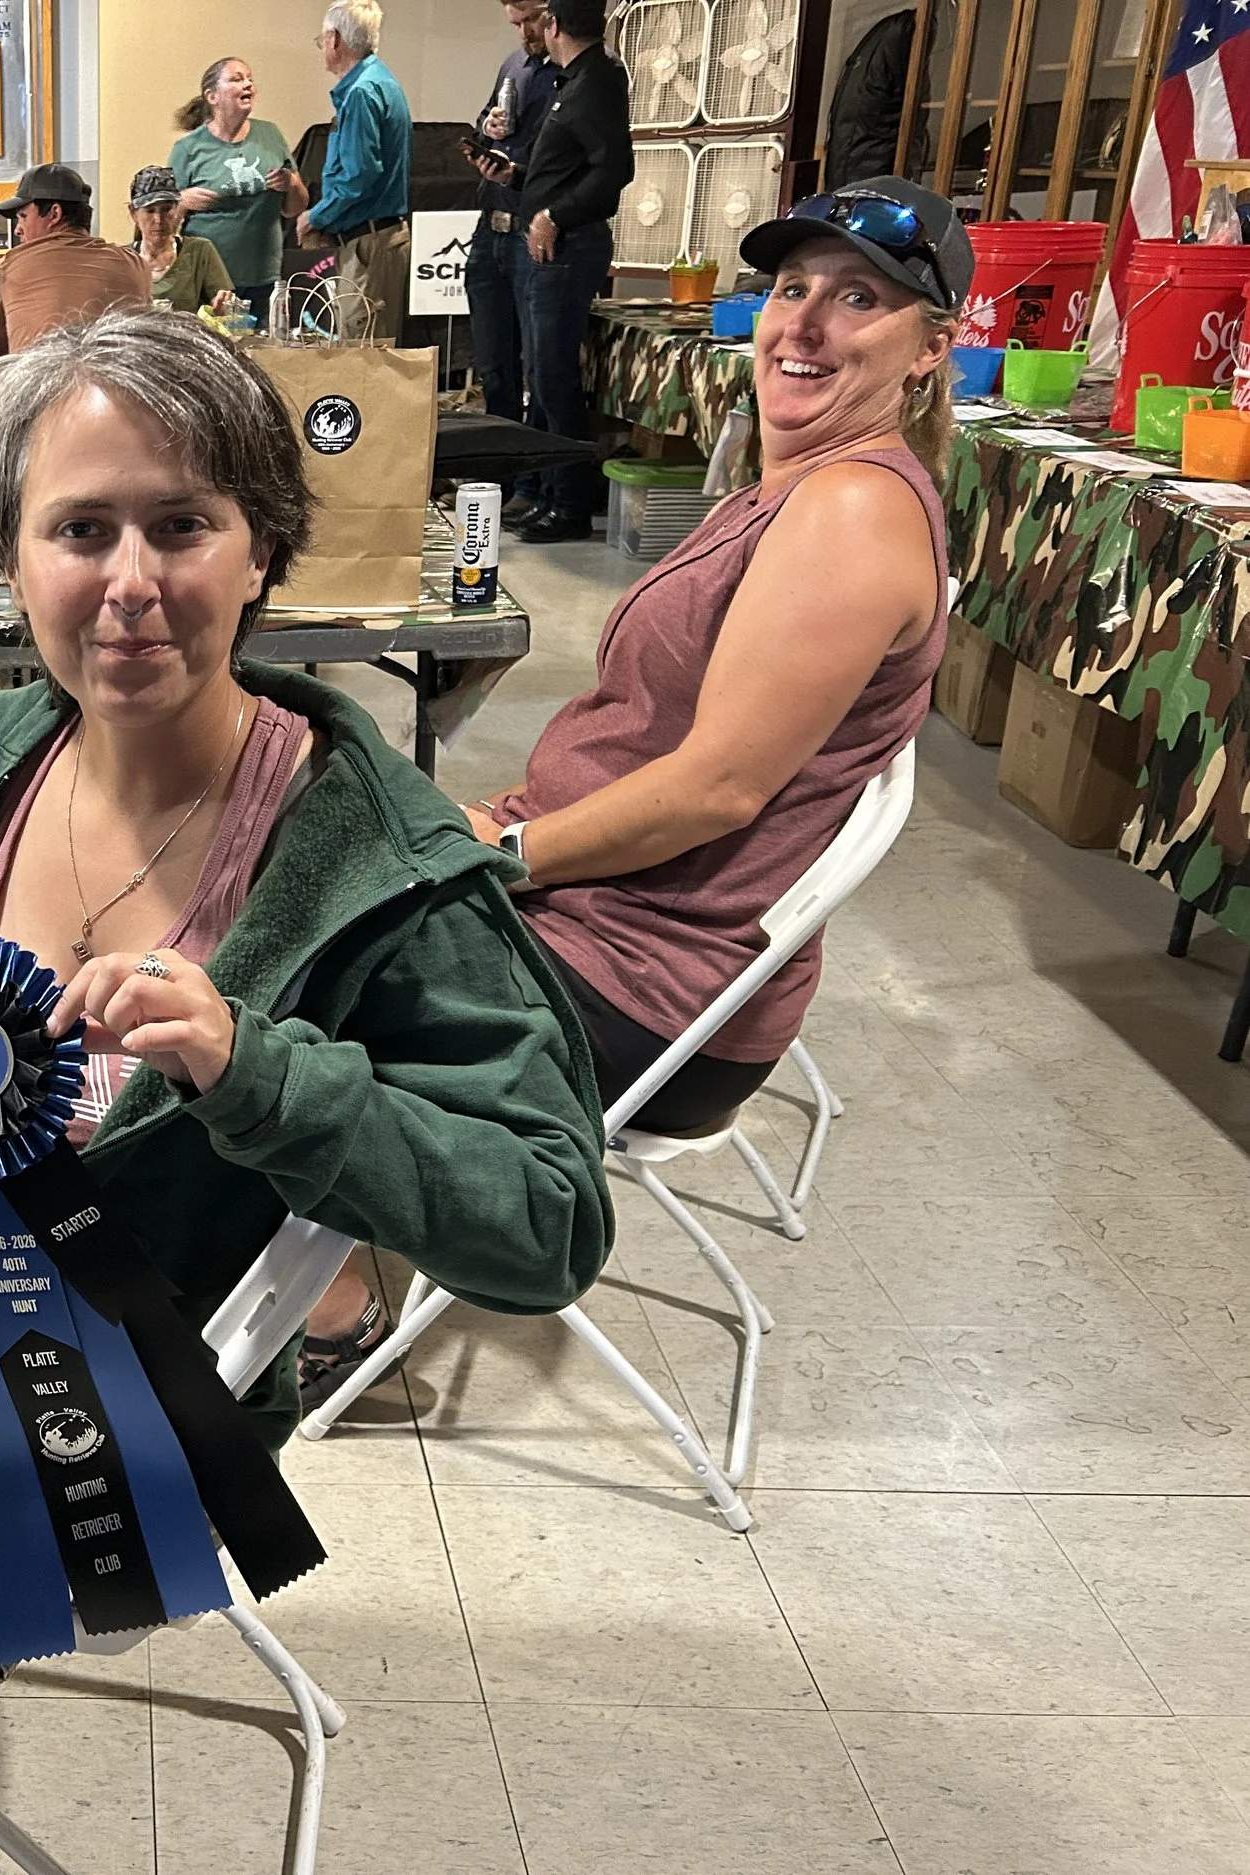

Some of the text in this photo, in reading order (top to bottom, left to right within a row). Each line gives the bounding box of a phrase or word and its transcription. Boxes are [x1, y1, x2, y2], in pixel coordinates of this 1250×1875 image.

[416, 263, 467, 280] SCH
[462, 501, 481, 565] Corona
[479, 517, 491, 553] Extra
[51, 1206, 101, 1242] STARTED
[2, 1257, 28, 1272] 40TH
[11, 1299, 38, 1314] HUNT
[22, 1351, 60, 1368] PLATTE
[32, 1380, 69, 1396] VALLEY
[64, 1477, 108, 1503] HUNTING
[71, 1513, 123, 1541] RETRIEVER
[94, 1554, 122, 1575] CLUB
